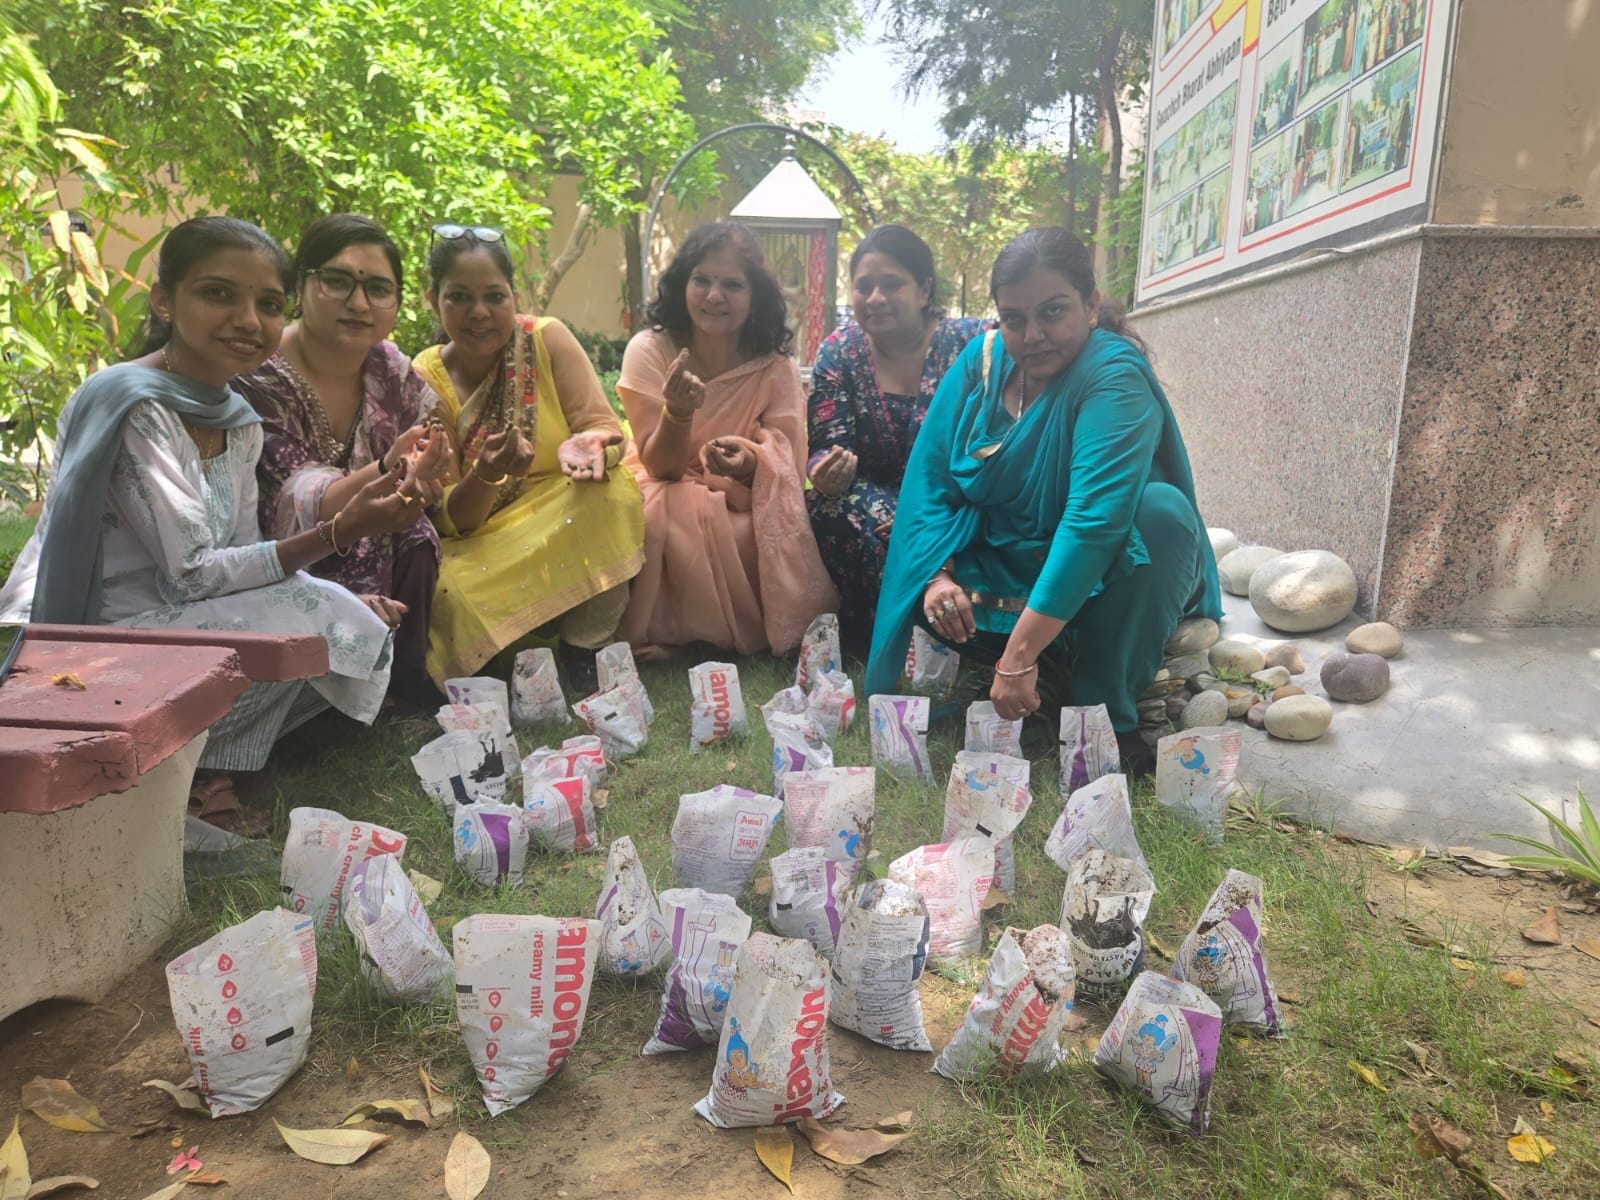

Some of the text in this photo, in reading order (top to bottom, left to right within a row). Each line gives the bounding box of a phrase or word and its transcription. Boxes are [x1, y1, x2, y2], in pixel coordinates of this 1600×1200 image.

[350, 824, 362, 841] ch
[529, 931, 544, 1019] reamy milk
[189, 1026, 205, 1057] milk
